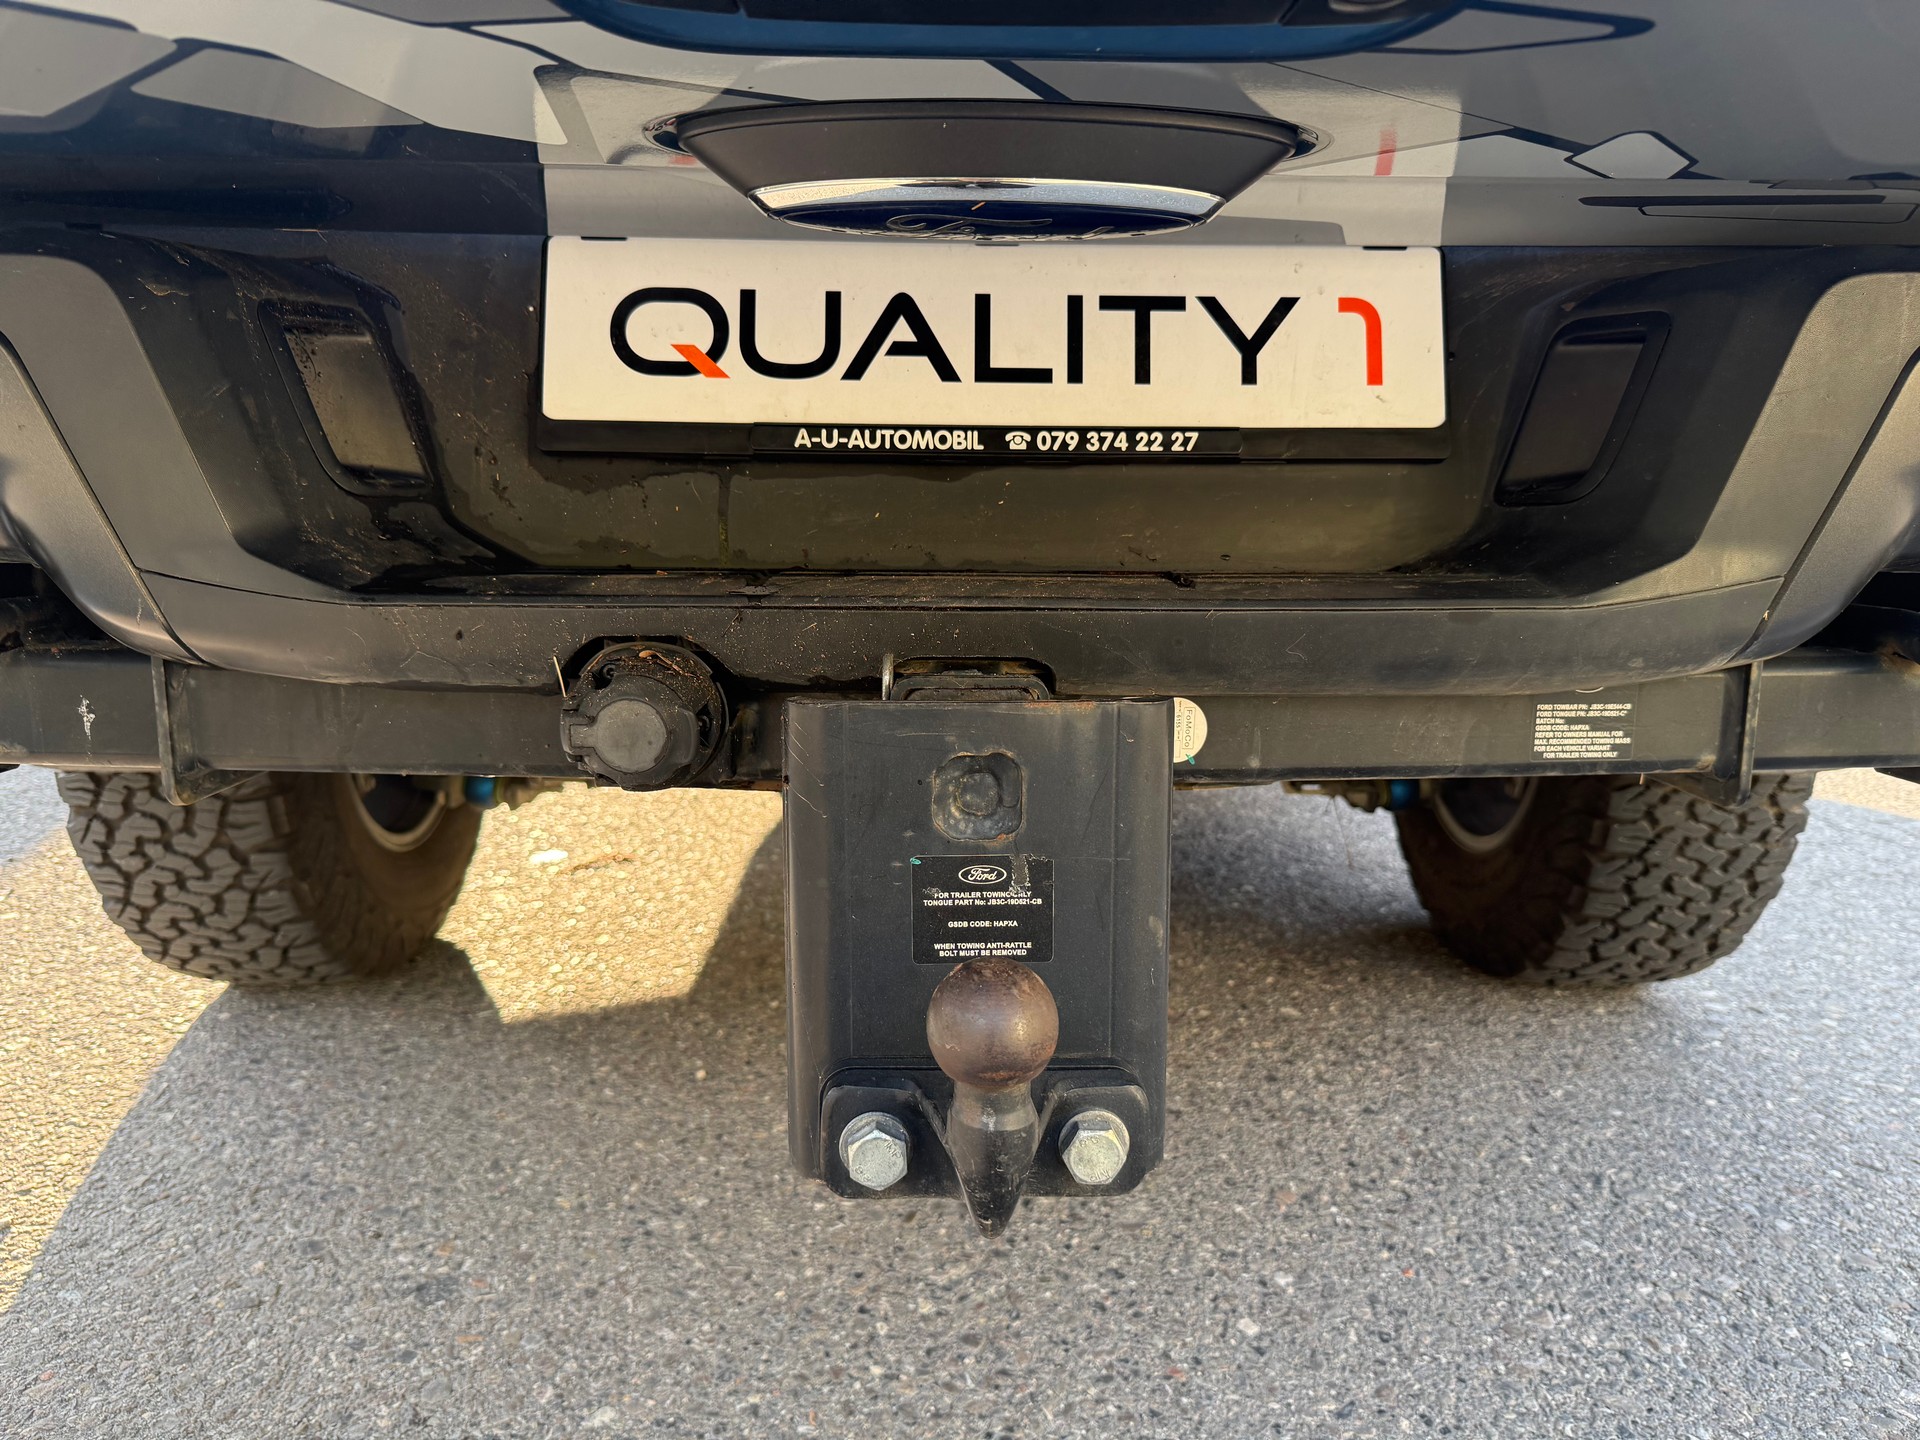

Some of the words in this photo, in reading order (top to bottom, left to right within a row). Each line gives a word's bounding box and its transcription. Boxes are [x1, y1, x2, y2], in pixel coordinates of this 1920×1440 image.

[610, 287, 1300, 385] QUALITY
[1337, 296, 1383, 386] 1
[793, 428, 984, 451] A-U-AUTOMOBIL
[1036, 430, 1079, 452] 079
[1086, 431, 1129, 452] 374
[1135, 432, 1164, 452] 22
[1171, 432, 1199, 452] 27
[1184, 709, 1193, 748] FoMoCo
[968, 868, 997, 881] Ford
